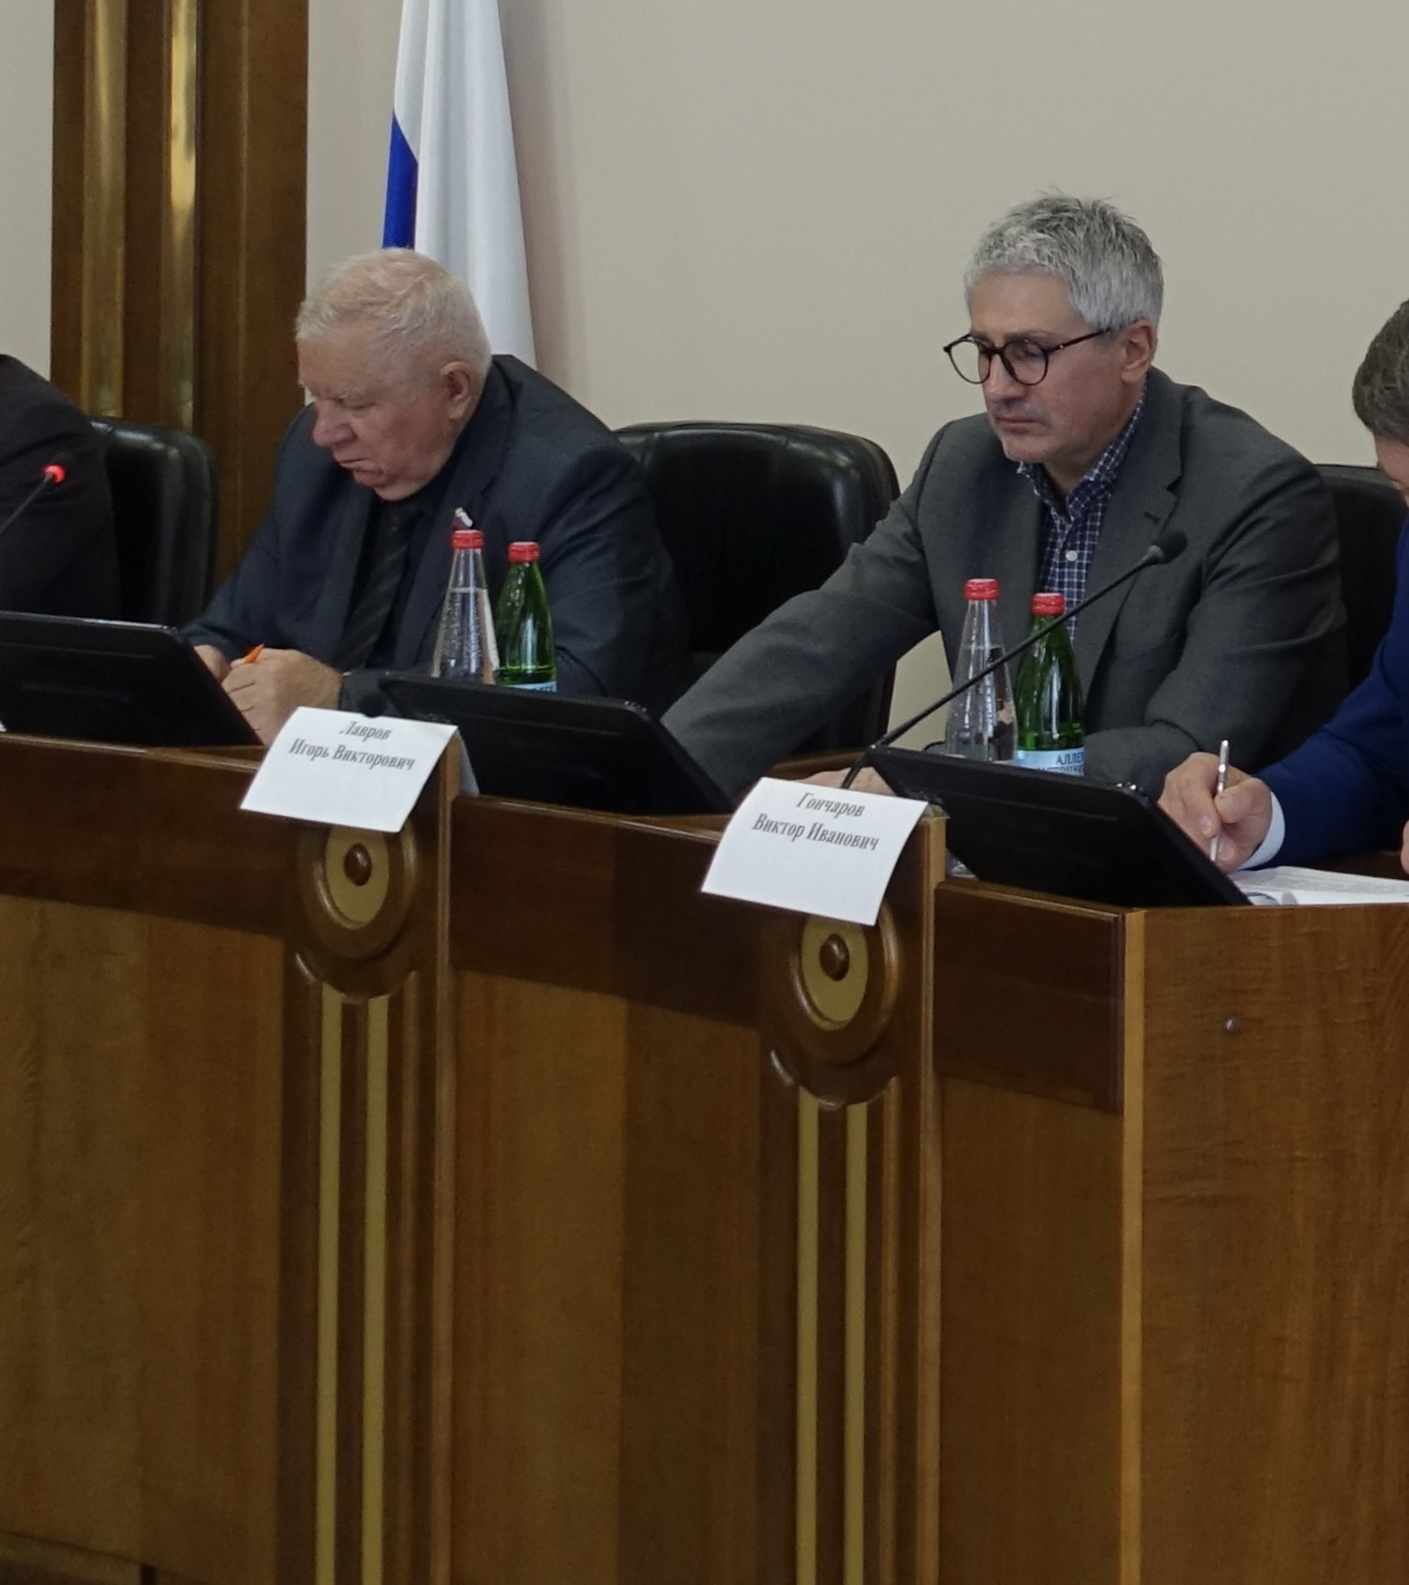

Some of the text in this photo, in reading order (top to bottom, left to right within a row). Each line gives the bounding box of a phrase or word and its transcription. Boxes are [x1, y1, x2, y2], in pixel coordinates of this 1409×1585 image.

[338, 720, 392, 742] Лавров
[288, 738, 416, 770] Игорь Викторович
[796, 792, 866, 820] Гончаров
[752, 813, 880, 852] Виктор Иванович
